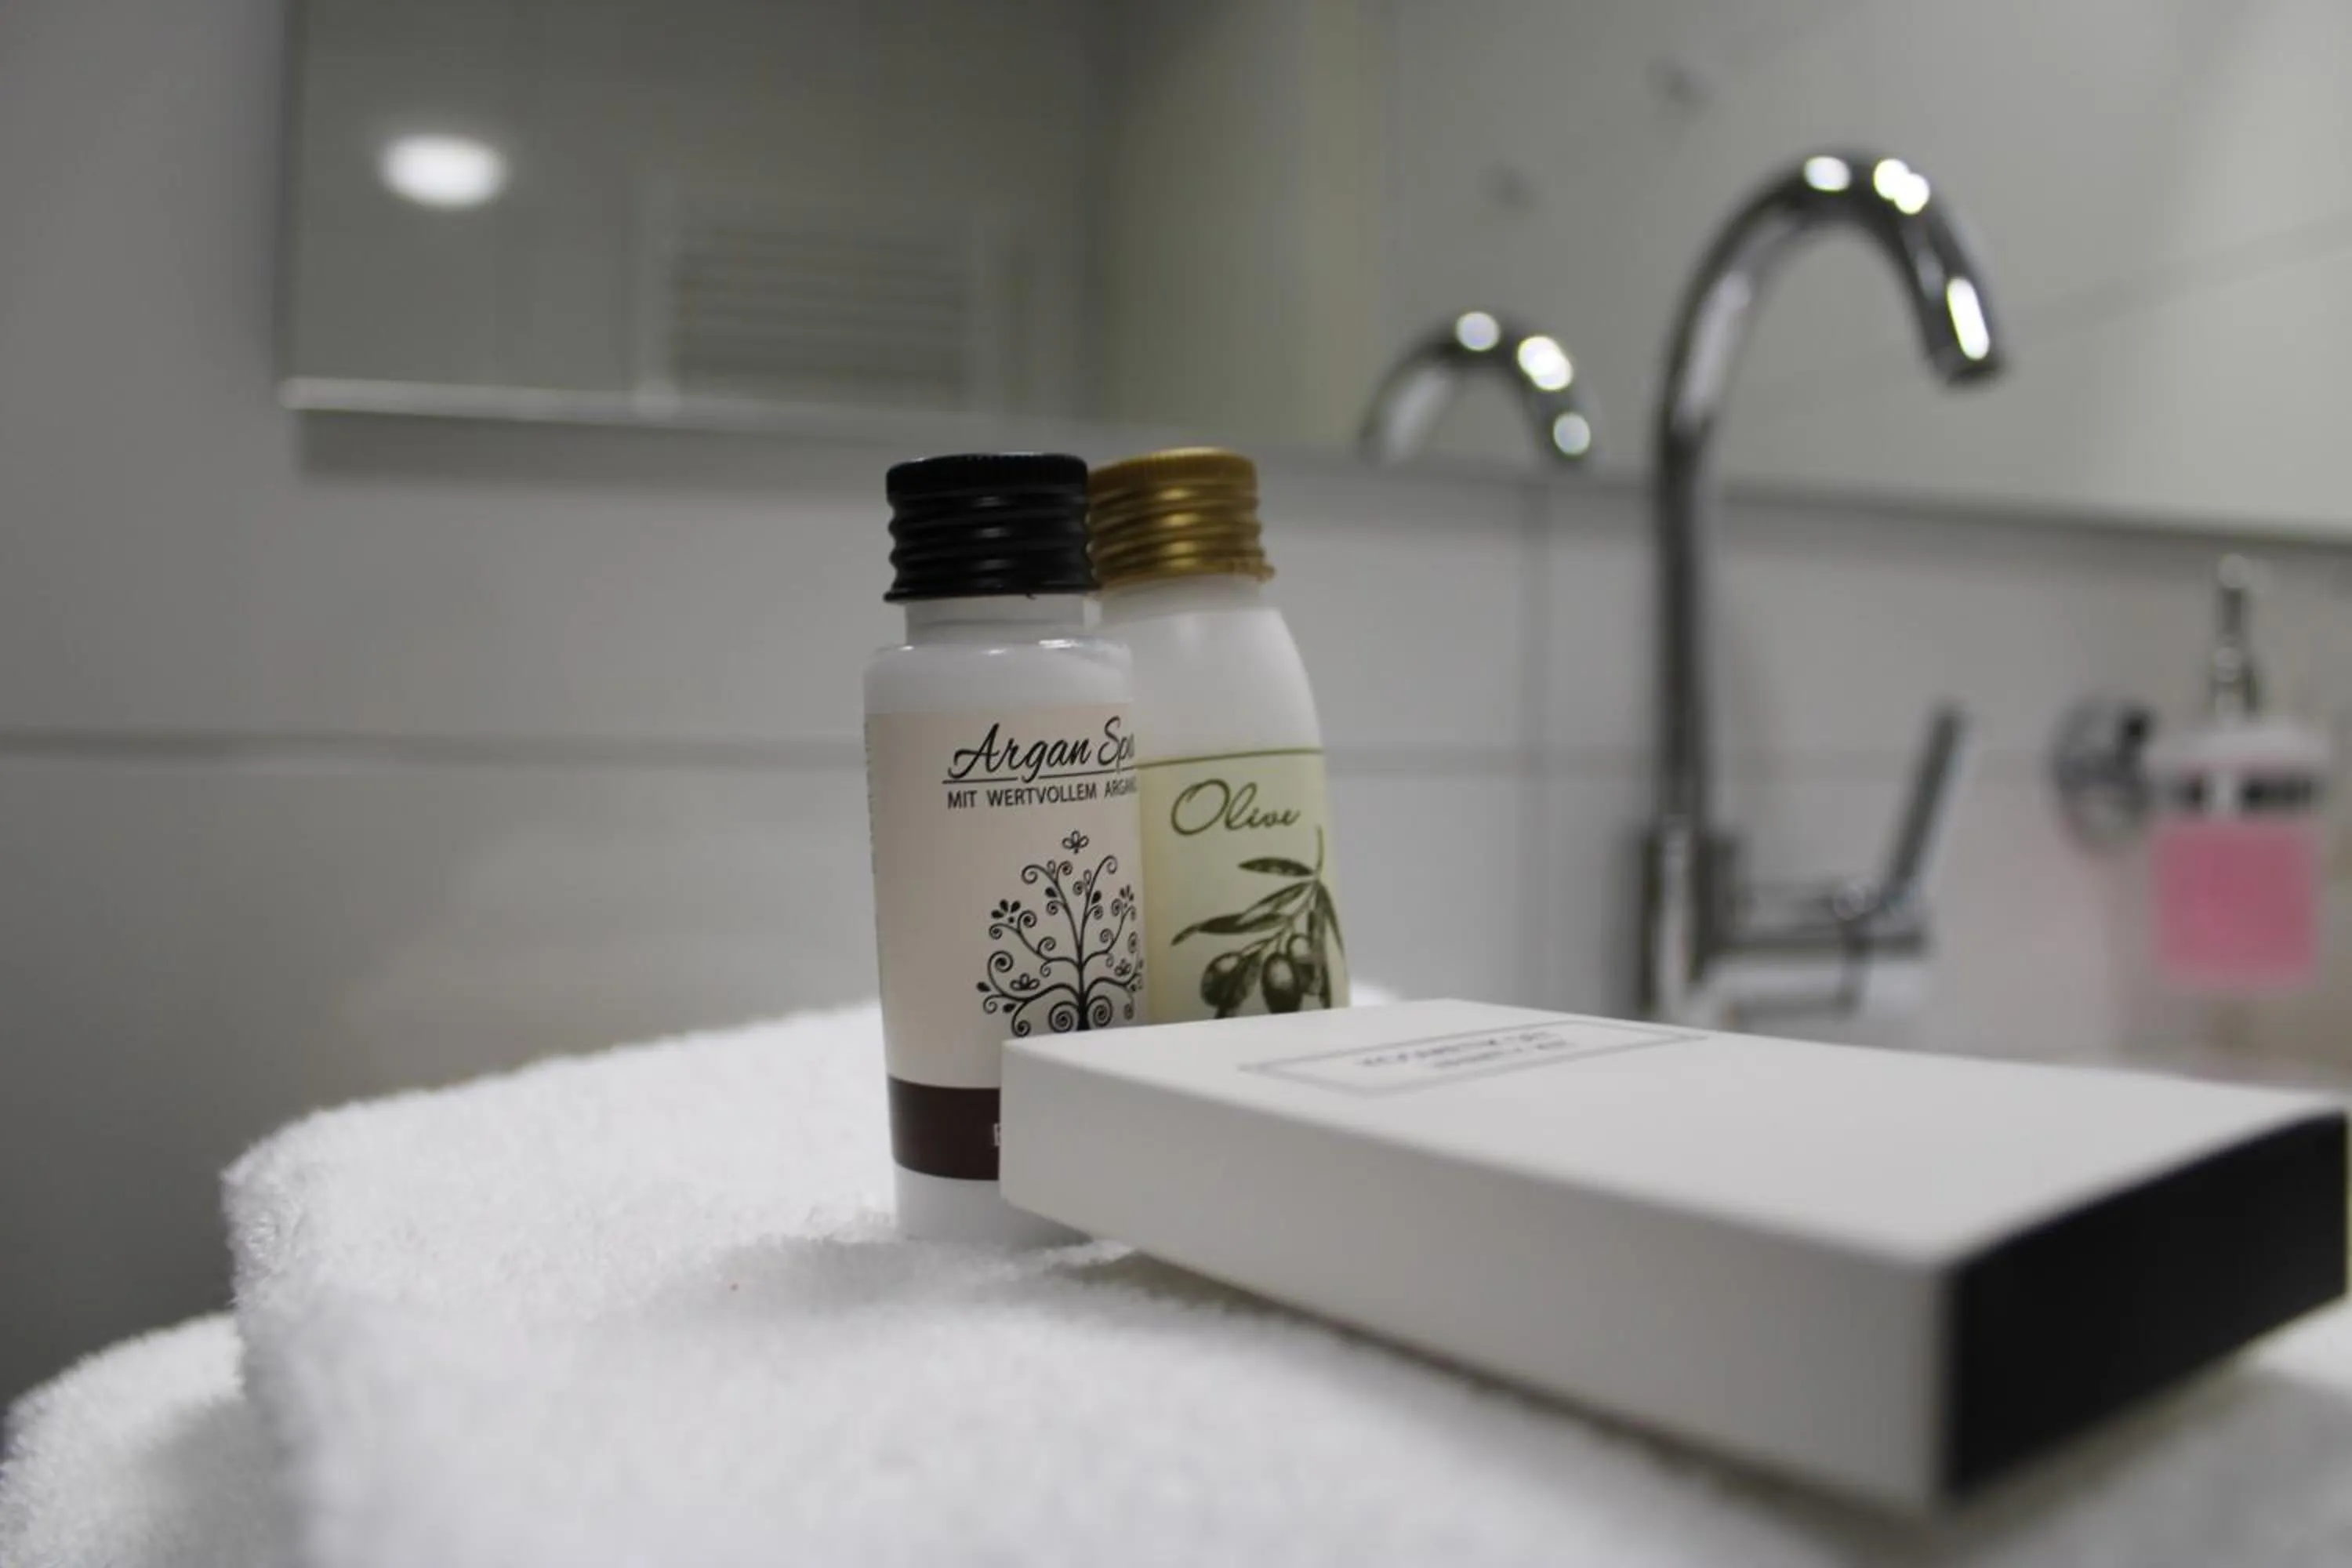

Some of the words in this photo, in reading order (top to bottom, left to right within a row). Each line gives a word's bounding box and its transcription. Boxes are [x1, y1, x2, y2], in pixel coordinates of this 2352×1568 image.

[947, 722, 1091, 783] Argan
[947, 789, 978, 810] MIT
[986, 782, 1098, 807] WERTVOLLEM
[1171, 779, 1301, 836] Olive
